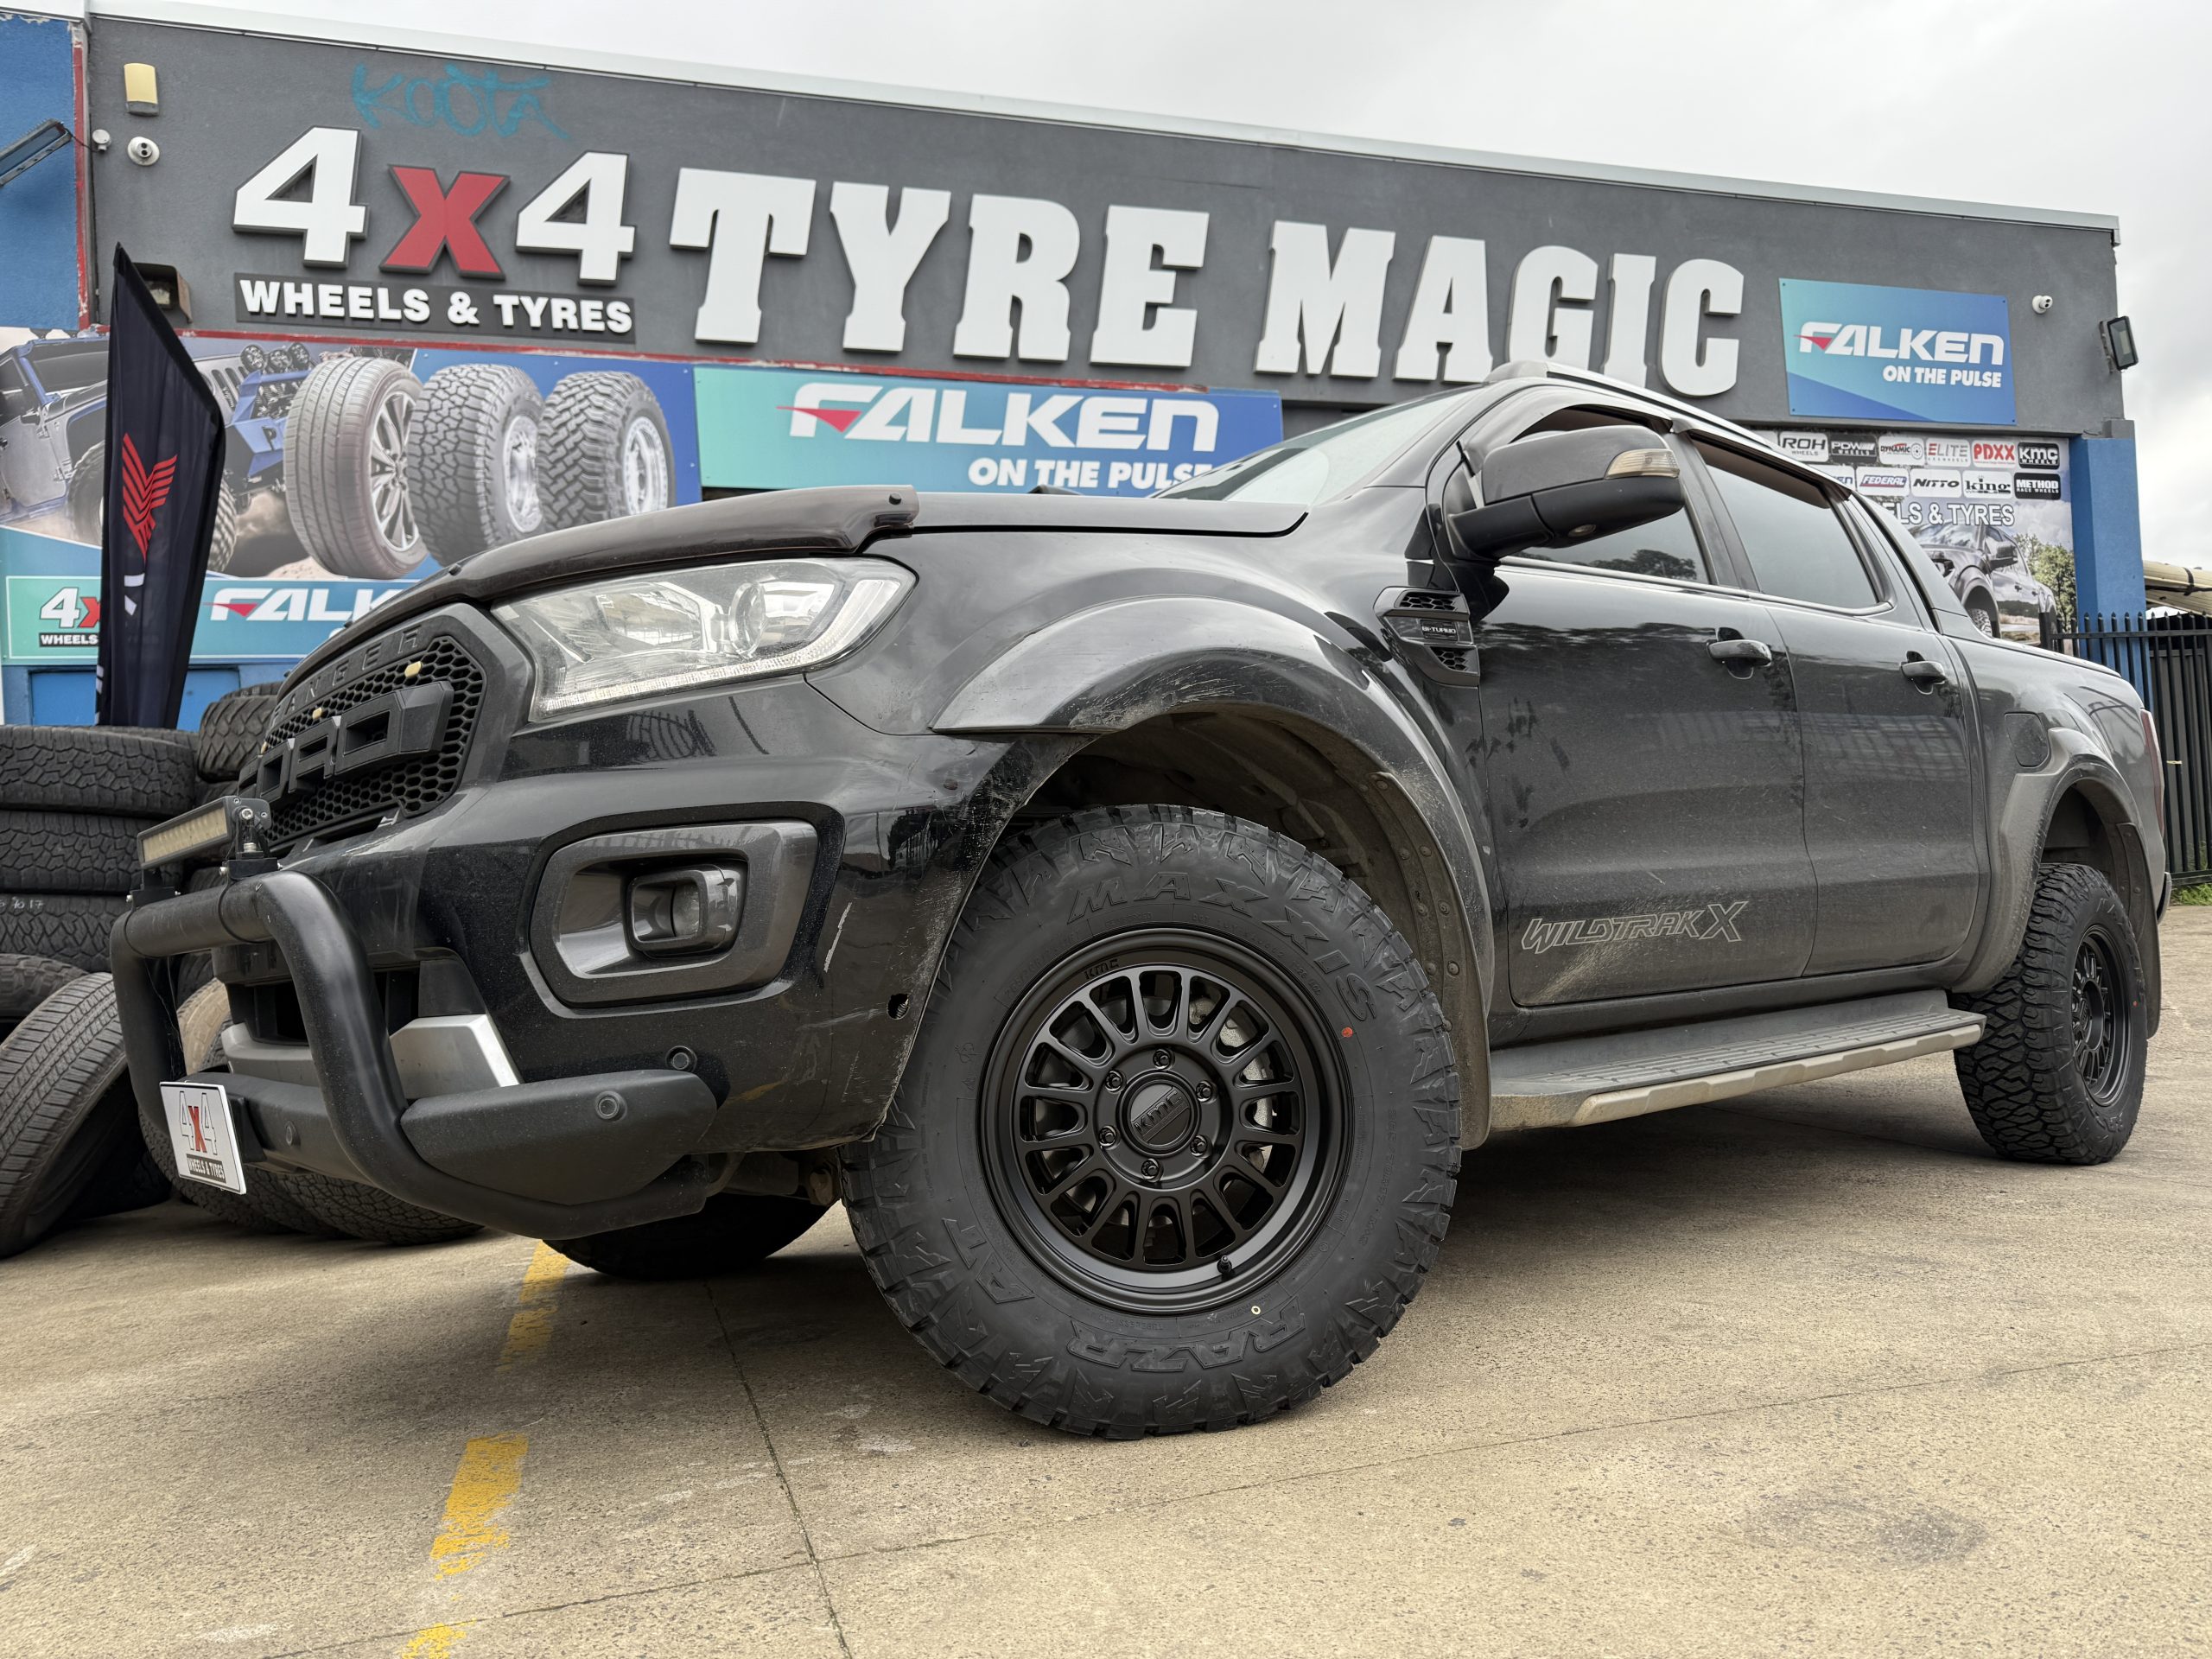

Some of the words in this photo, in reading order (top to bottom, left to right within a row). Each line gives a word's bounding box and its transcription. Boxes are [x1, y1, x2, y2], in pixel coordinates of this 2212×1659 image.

[670, 167, 1209, 368] TYRE
[1254, 219, 1745, 397] MAGIC
[239, 279, 431, 322] WHEELS
[447, 291, 480, 326] &
[493, 295, 632, 334] TYRES
[1796, 321, 2005, 365] FALKEN
[1883, 365, 1912, 382] ON
[1914, 367, 1947, 385] THE
[1950, 369, 2002, 388] PULSE
[779, 382, 1219, 453] FALKEN
[1783, 437, 1826, 450] ROH
[1928, 443, 1968, 457] ELITE
[1974, 442, 2016, 461] PDXX
[968, 457, 1027, 486] ON
[1034, 460, 1100, 488] THE
[1863, 476, 1907, 486] FEDERAL
[1913, 478, 1960, 488] NITTO
[2016, 479, 2059, 489] METHOD
[1947, 503, 2015, 526] TYRES
[207, 588, 404, 621] FALK
[40, 634, 99, 645] WHEELS
[1521, 909, 1705, 954] WILDTRAK
[1067, 871, 1377, 1021] MAXXIS
[1066, 1296, 1306, 1373] RAZR
